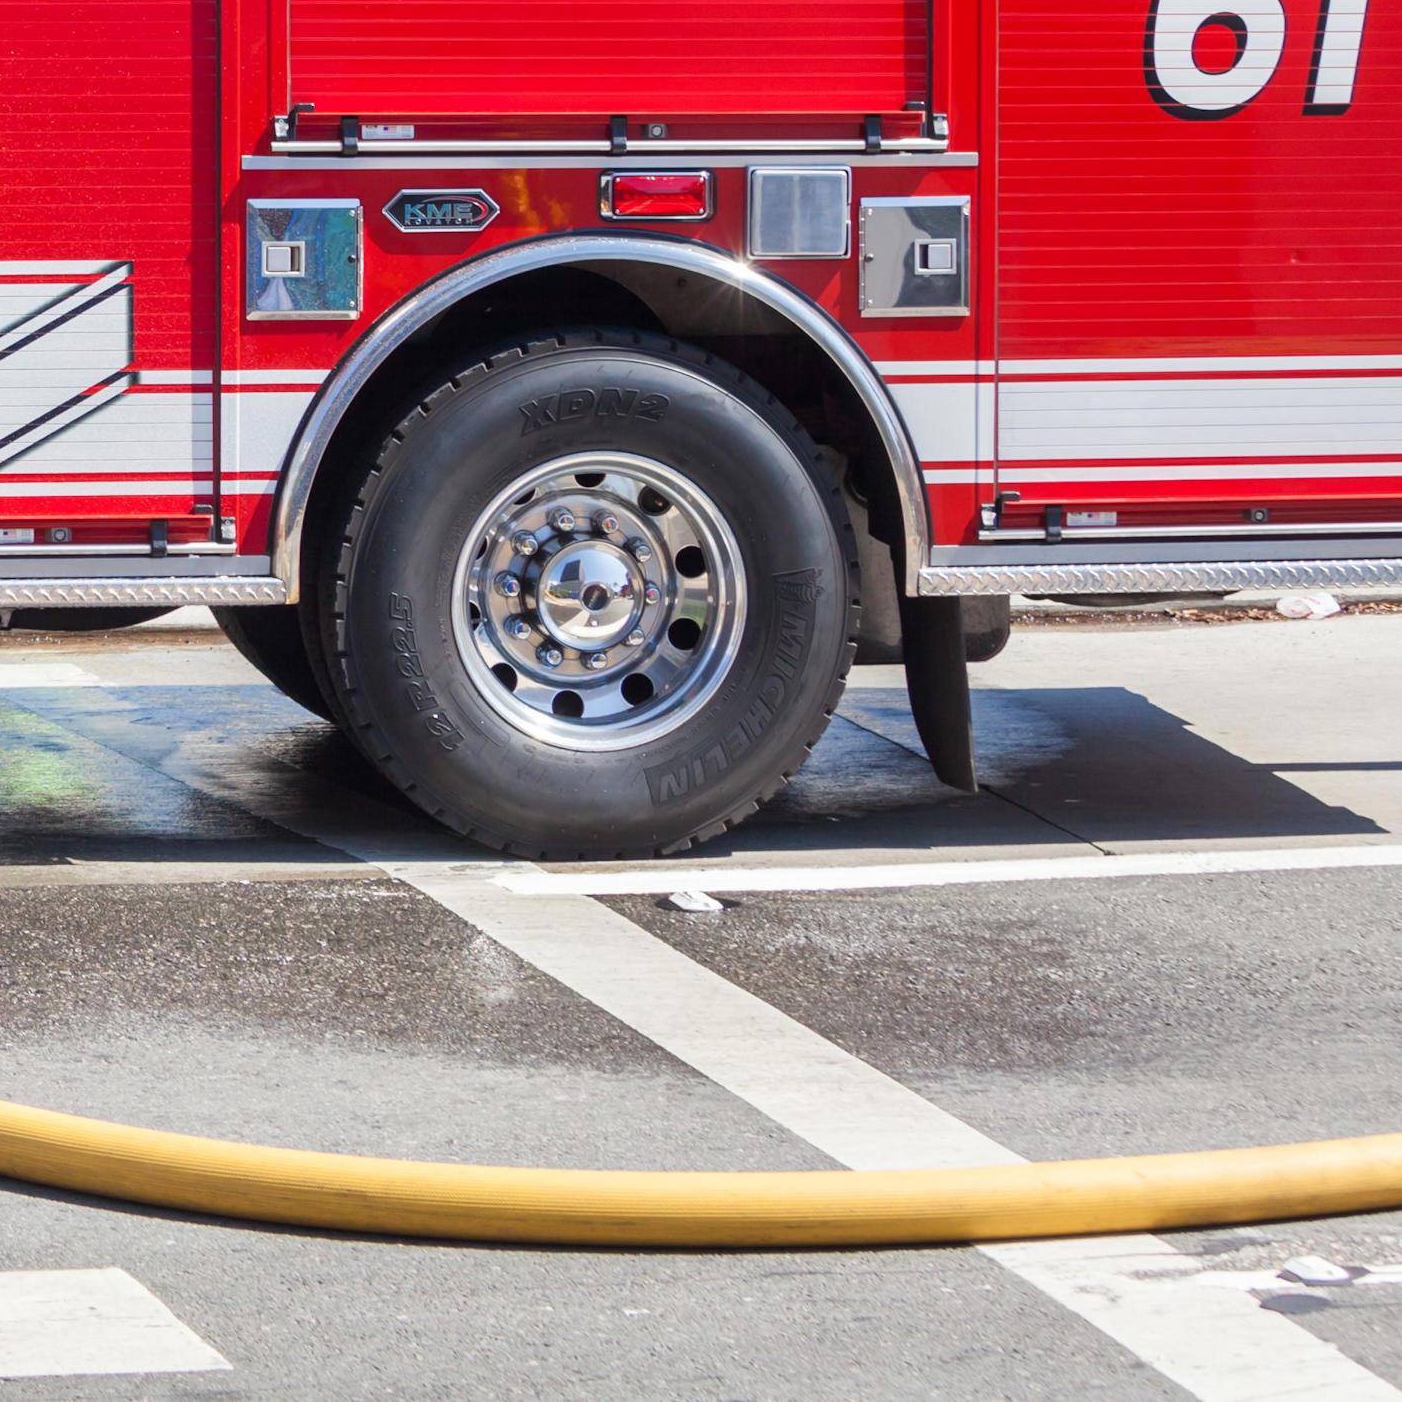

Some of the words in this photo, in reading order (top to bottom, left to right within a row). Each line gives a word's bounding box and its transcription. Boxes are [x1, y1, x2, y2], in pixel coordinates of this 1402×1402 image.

[404, 203, 473, 219] KME
[517, 387, 671, 435] XDN2
[658, 608, 815, 803] MICHELIN
